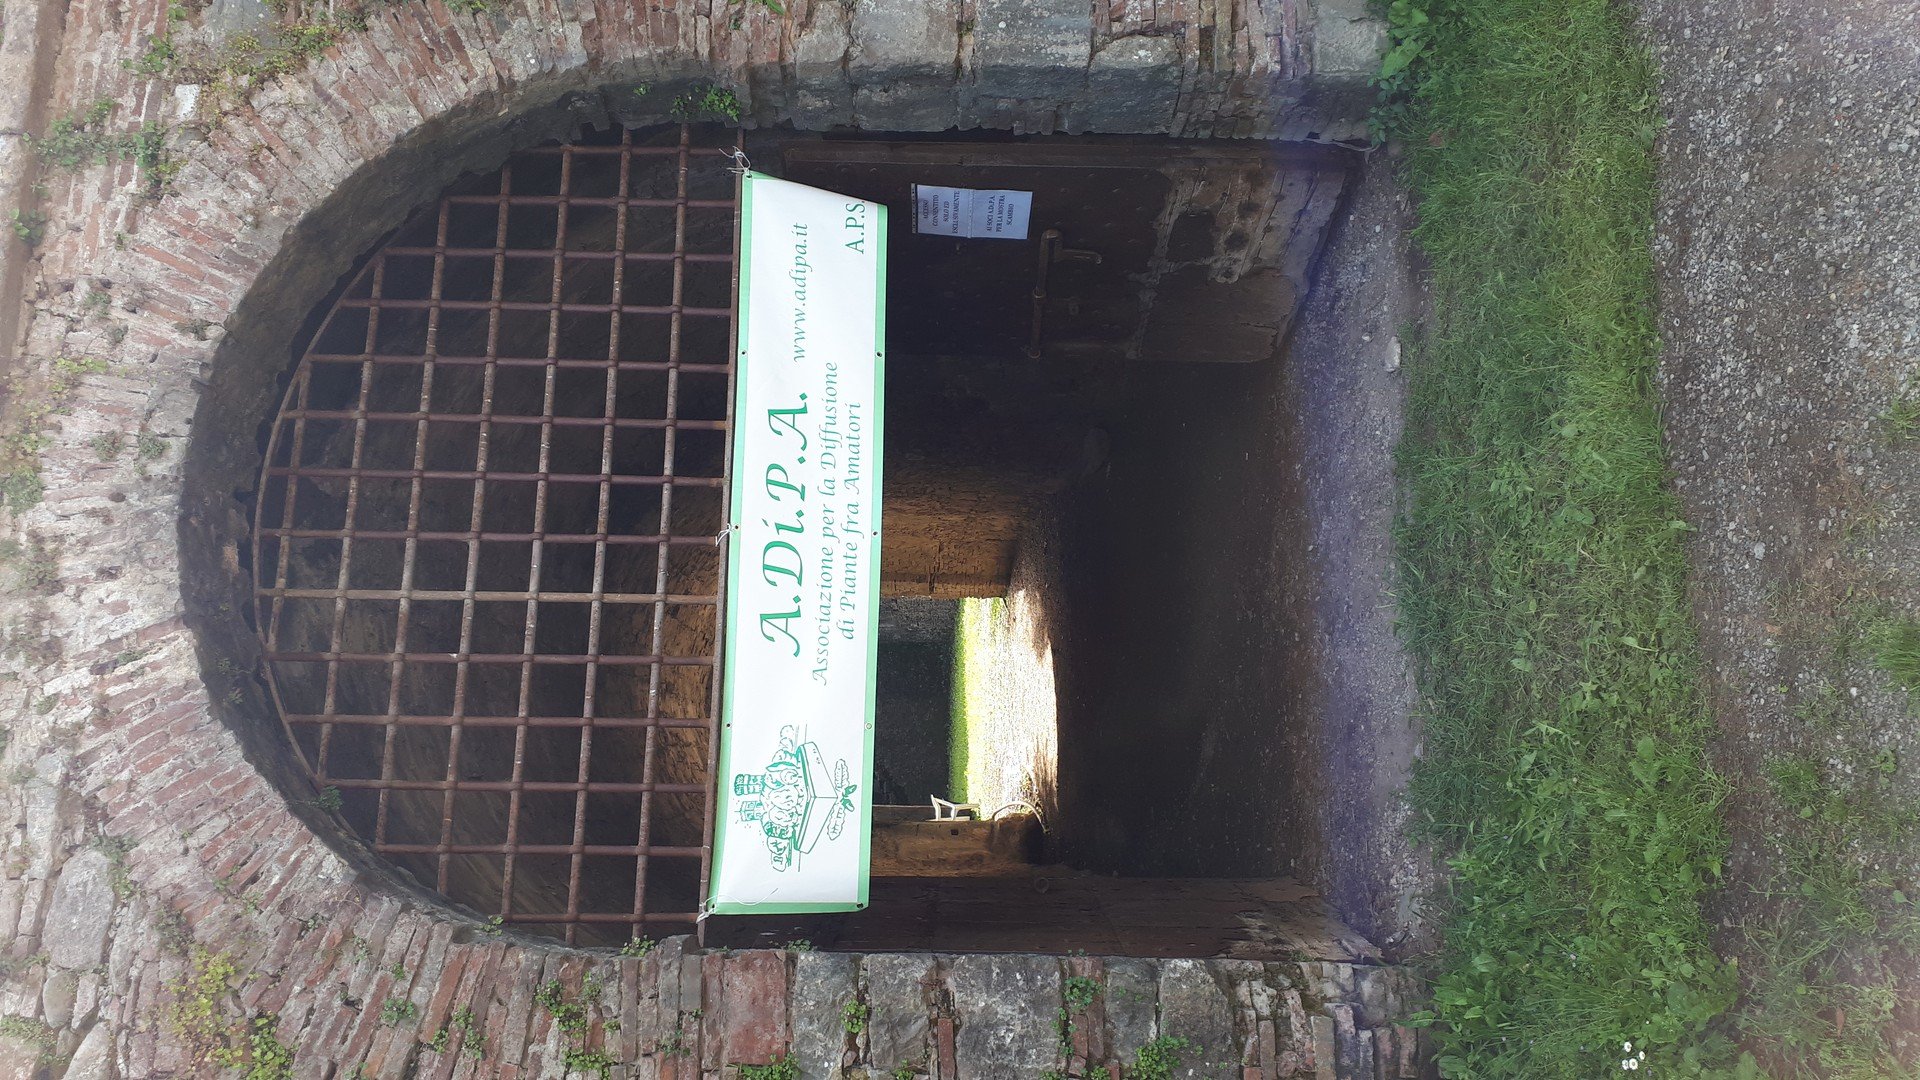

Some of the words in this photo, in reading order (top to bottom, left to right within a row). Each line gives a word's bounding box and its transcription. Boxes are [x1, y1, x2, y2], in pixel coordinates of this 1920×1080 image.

[844, 200, 866, 254] A.P.S.
[788, 222, 812, 362] www.adipa.it
[818, 362, 842, 470] Diffusione
[843, 402, 862, 495] Amatori
[816, 478, 836, 496] la
[840, 502, 864, 539] fra
[760, 392, 808, 658] A.Di.P.A.
[821, 504, 840, 543] per
[839, 542, 858, 612] Piante
[812, 546, 834, 686] Associazione
[836, 618, 855, 640] di
